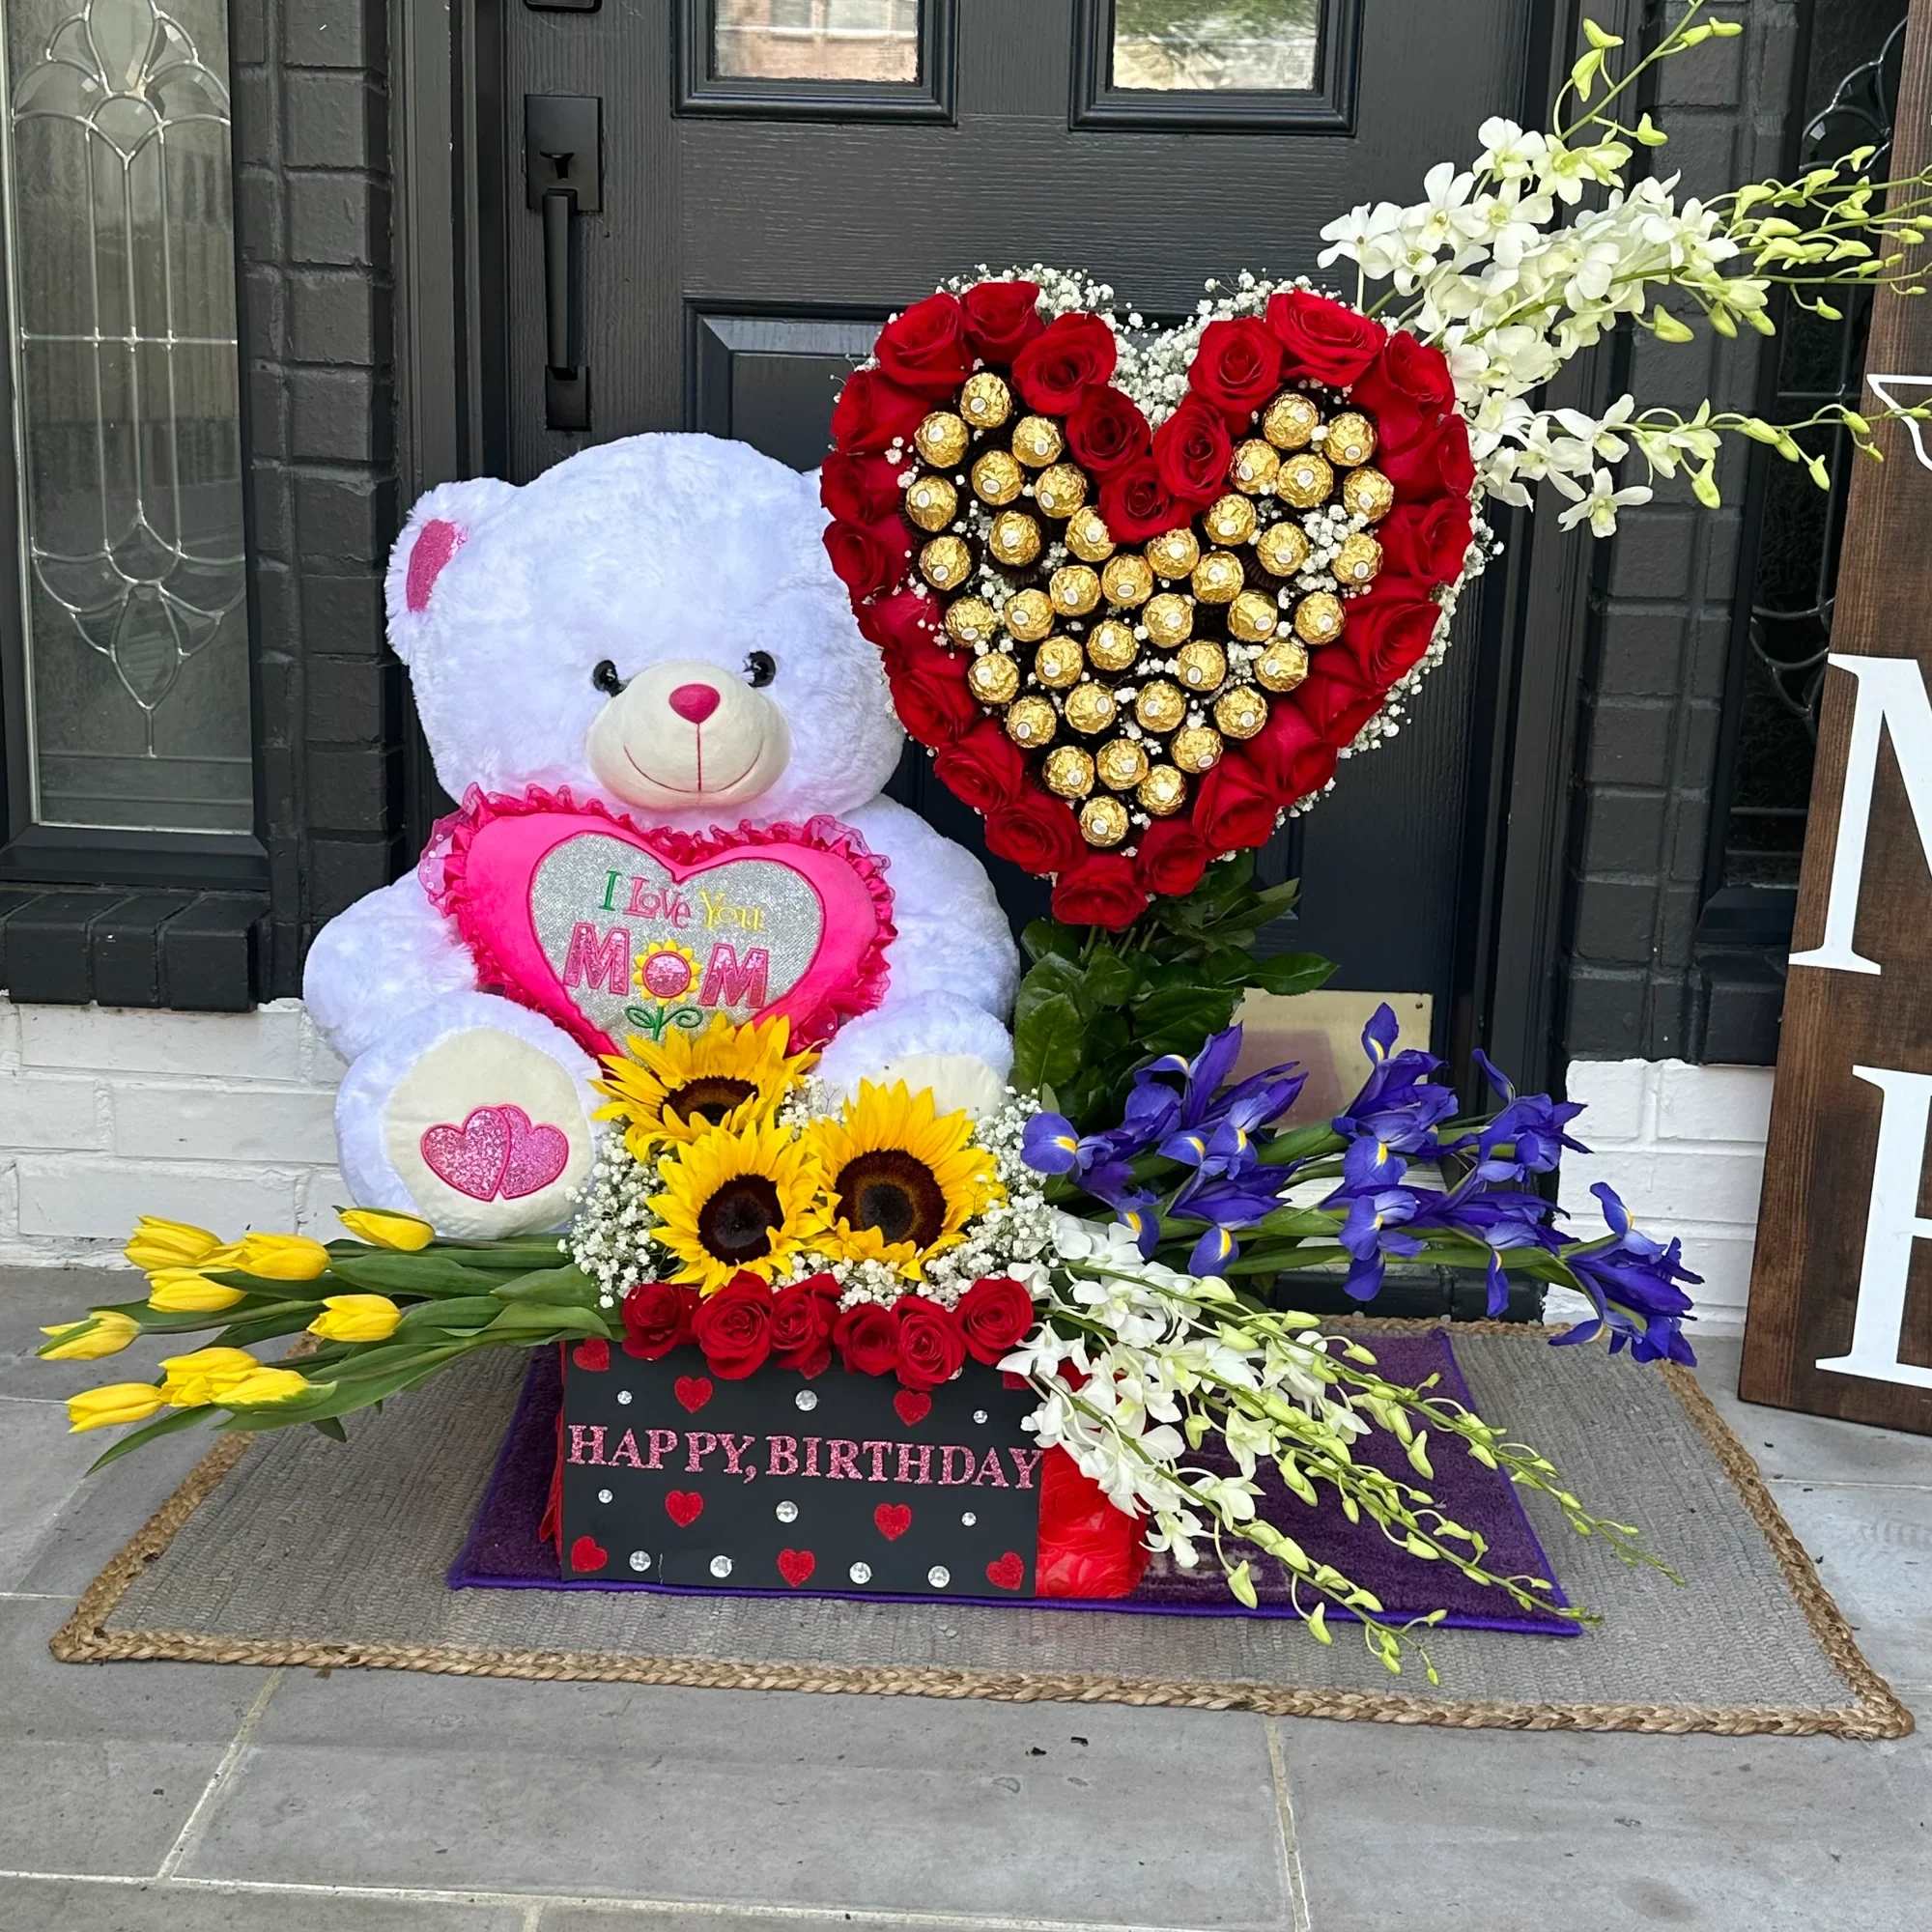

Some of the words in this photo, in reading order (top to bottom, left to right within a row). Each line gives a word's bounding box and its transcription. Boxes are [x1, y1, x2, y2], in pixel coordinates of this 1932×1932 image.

[598, 870, 622, 911] I
[624, 875, 693, 929] Love
[699, 888, 766, 931] You
[563, 922, 770, 1009] MOM
[765, 1435, 1044, 1490] BIRTHDAY
